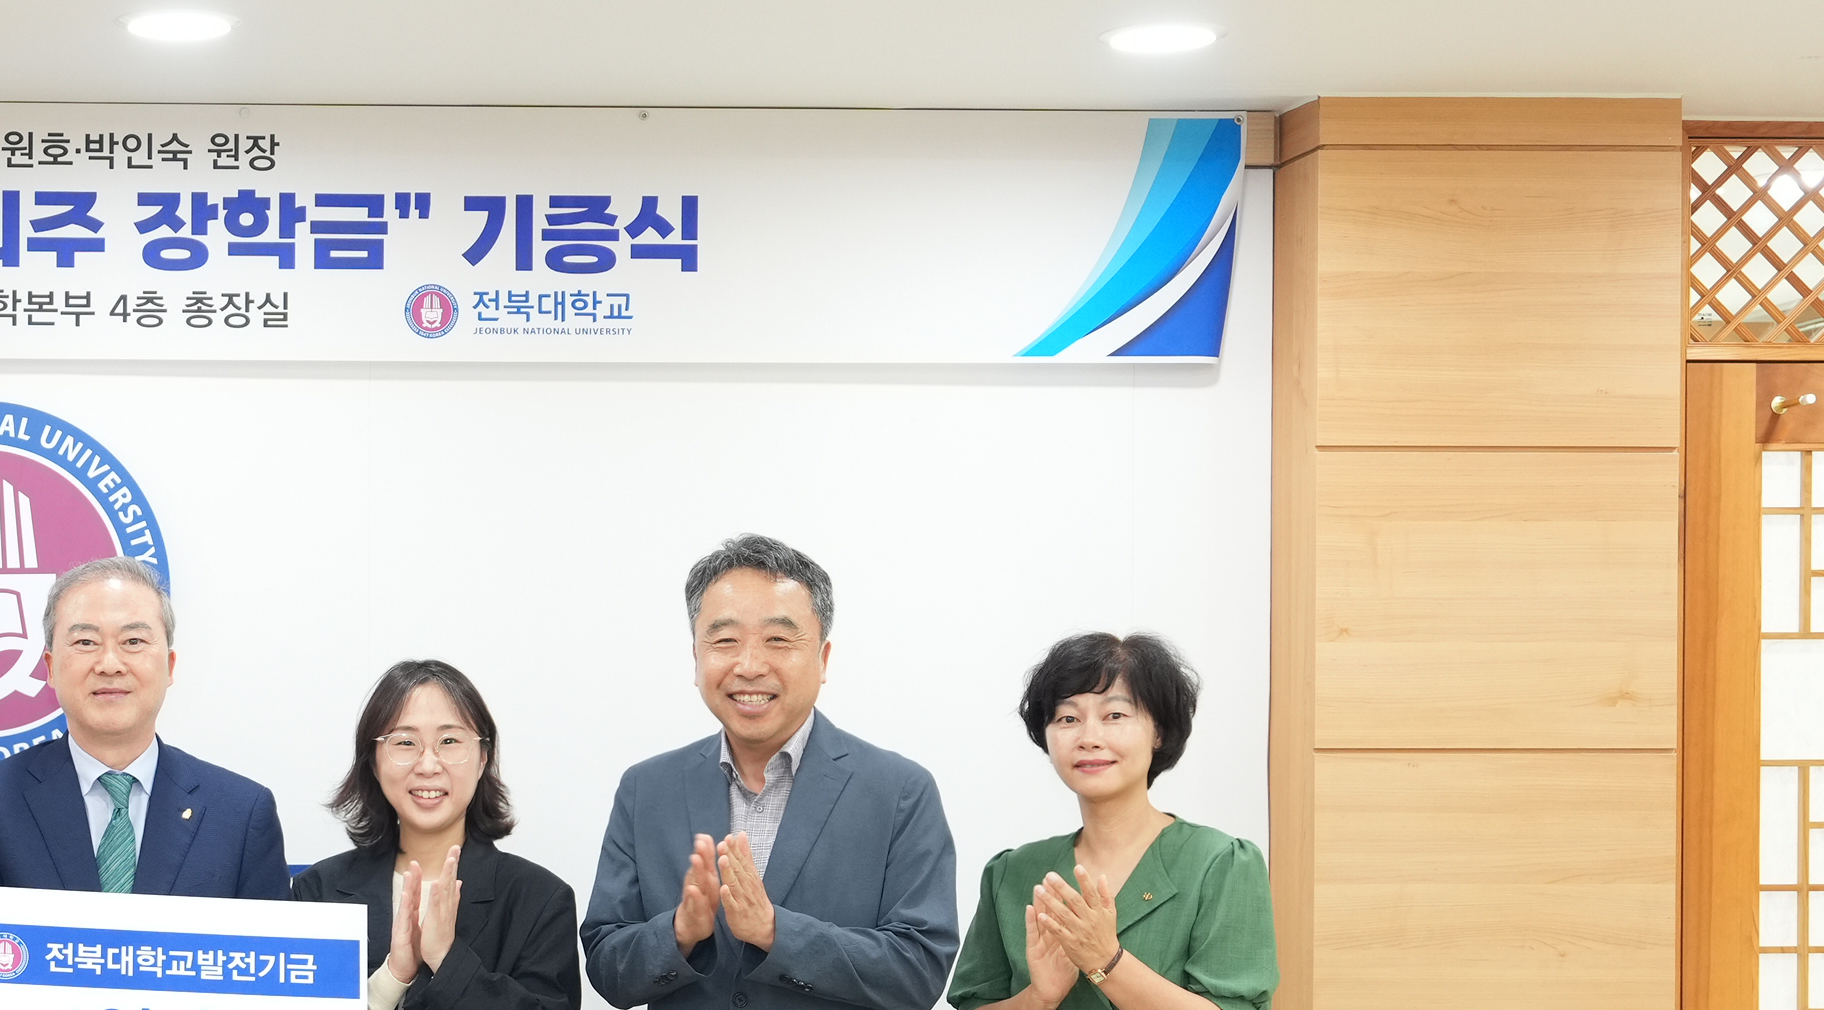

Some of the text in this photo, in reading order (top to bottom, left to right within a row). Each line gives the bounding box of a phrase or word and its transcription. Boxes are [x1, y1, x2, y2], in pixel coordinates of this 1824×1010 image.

[208, 133, 280, 171] 원장
[134, 189, 431, 271] 장학금”
[462, 194, 698, 274] 기증식
[110, 291, 167, 328] 4층
[182, 291, 288, 328] 총장실
[473, 290, 633, 322] 전북대학교
[40, 425, 158, 565] UNIVERSITY
[44, 940, 318, 984] 전북대학교발전기금
